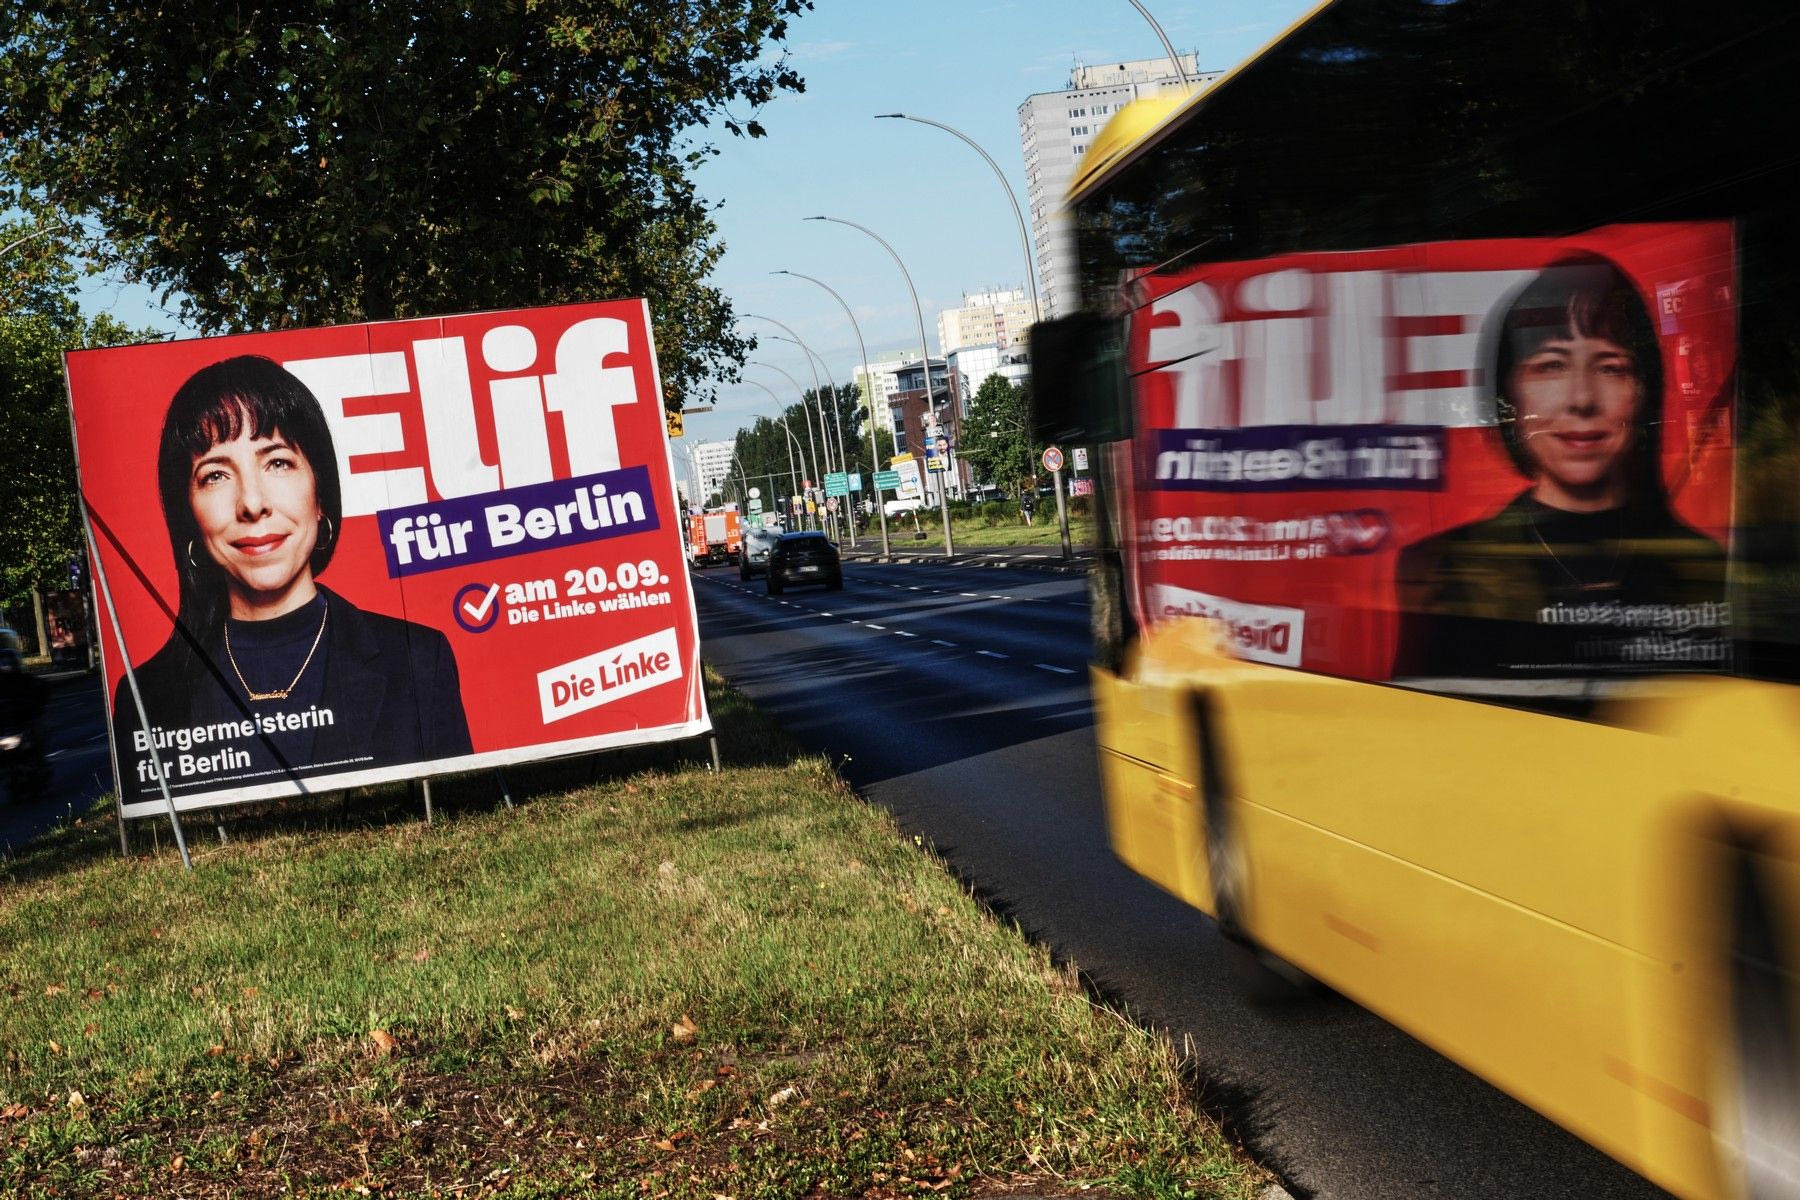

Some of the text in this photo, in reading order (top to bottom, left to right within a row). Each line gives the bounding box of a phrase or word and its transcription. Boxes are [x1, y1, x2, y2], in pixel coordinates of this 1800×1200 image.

[282, 317, 638, 518] Elif
[390, 484, 646, 565] für Berlin
[504, 560, 669, 604] am 20.09.
[508, 590, 671, 625] Die Linke wählen
[551, 650, 670, 708] Die Linke
[133, 705, 334, 751] Bürgermeisterin
[137, 759, 174, 783] für
[179, 747, 251, 777] Berlin
